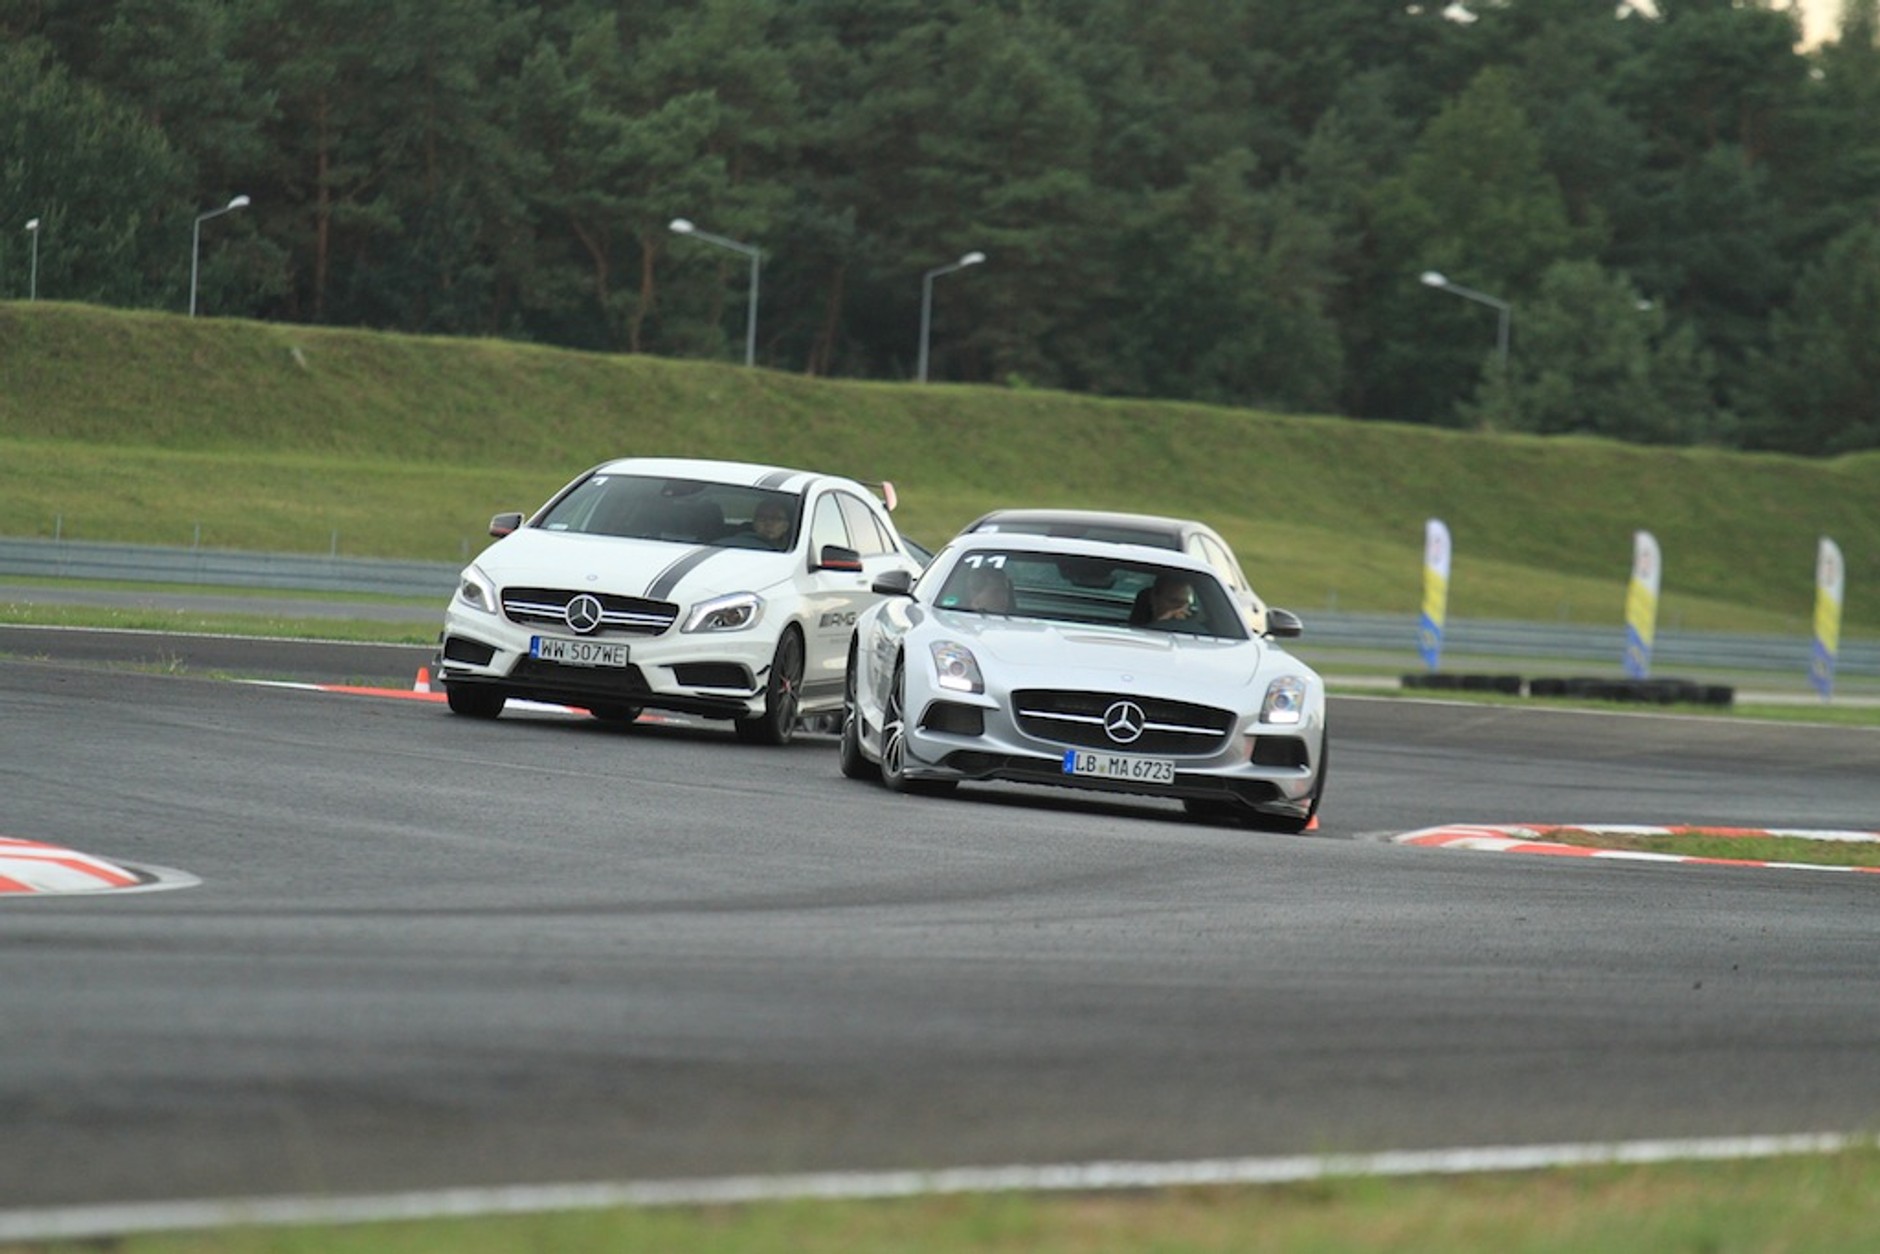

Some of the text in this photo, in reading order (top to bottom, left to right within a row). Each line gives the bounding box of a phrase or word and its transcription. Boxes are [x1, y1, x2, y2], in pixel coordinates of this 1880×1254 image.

[964, 555, 1007, 569] 11
[830, 611, 857, 627] AMG
[541, 640, 625, 664] WW 507WE
[1075, 755, 1173, 780] LB MA 6723
